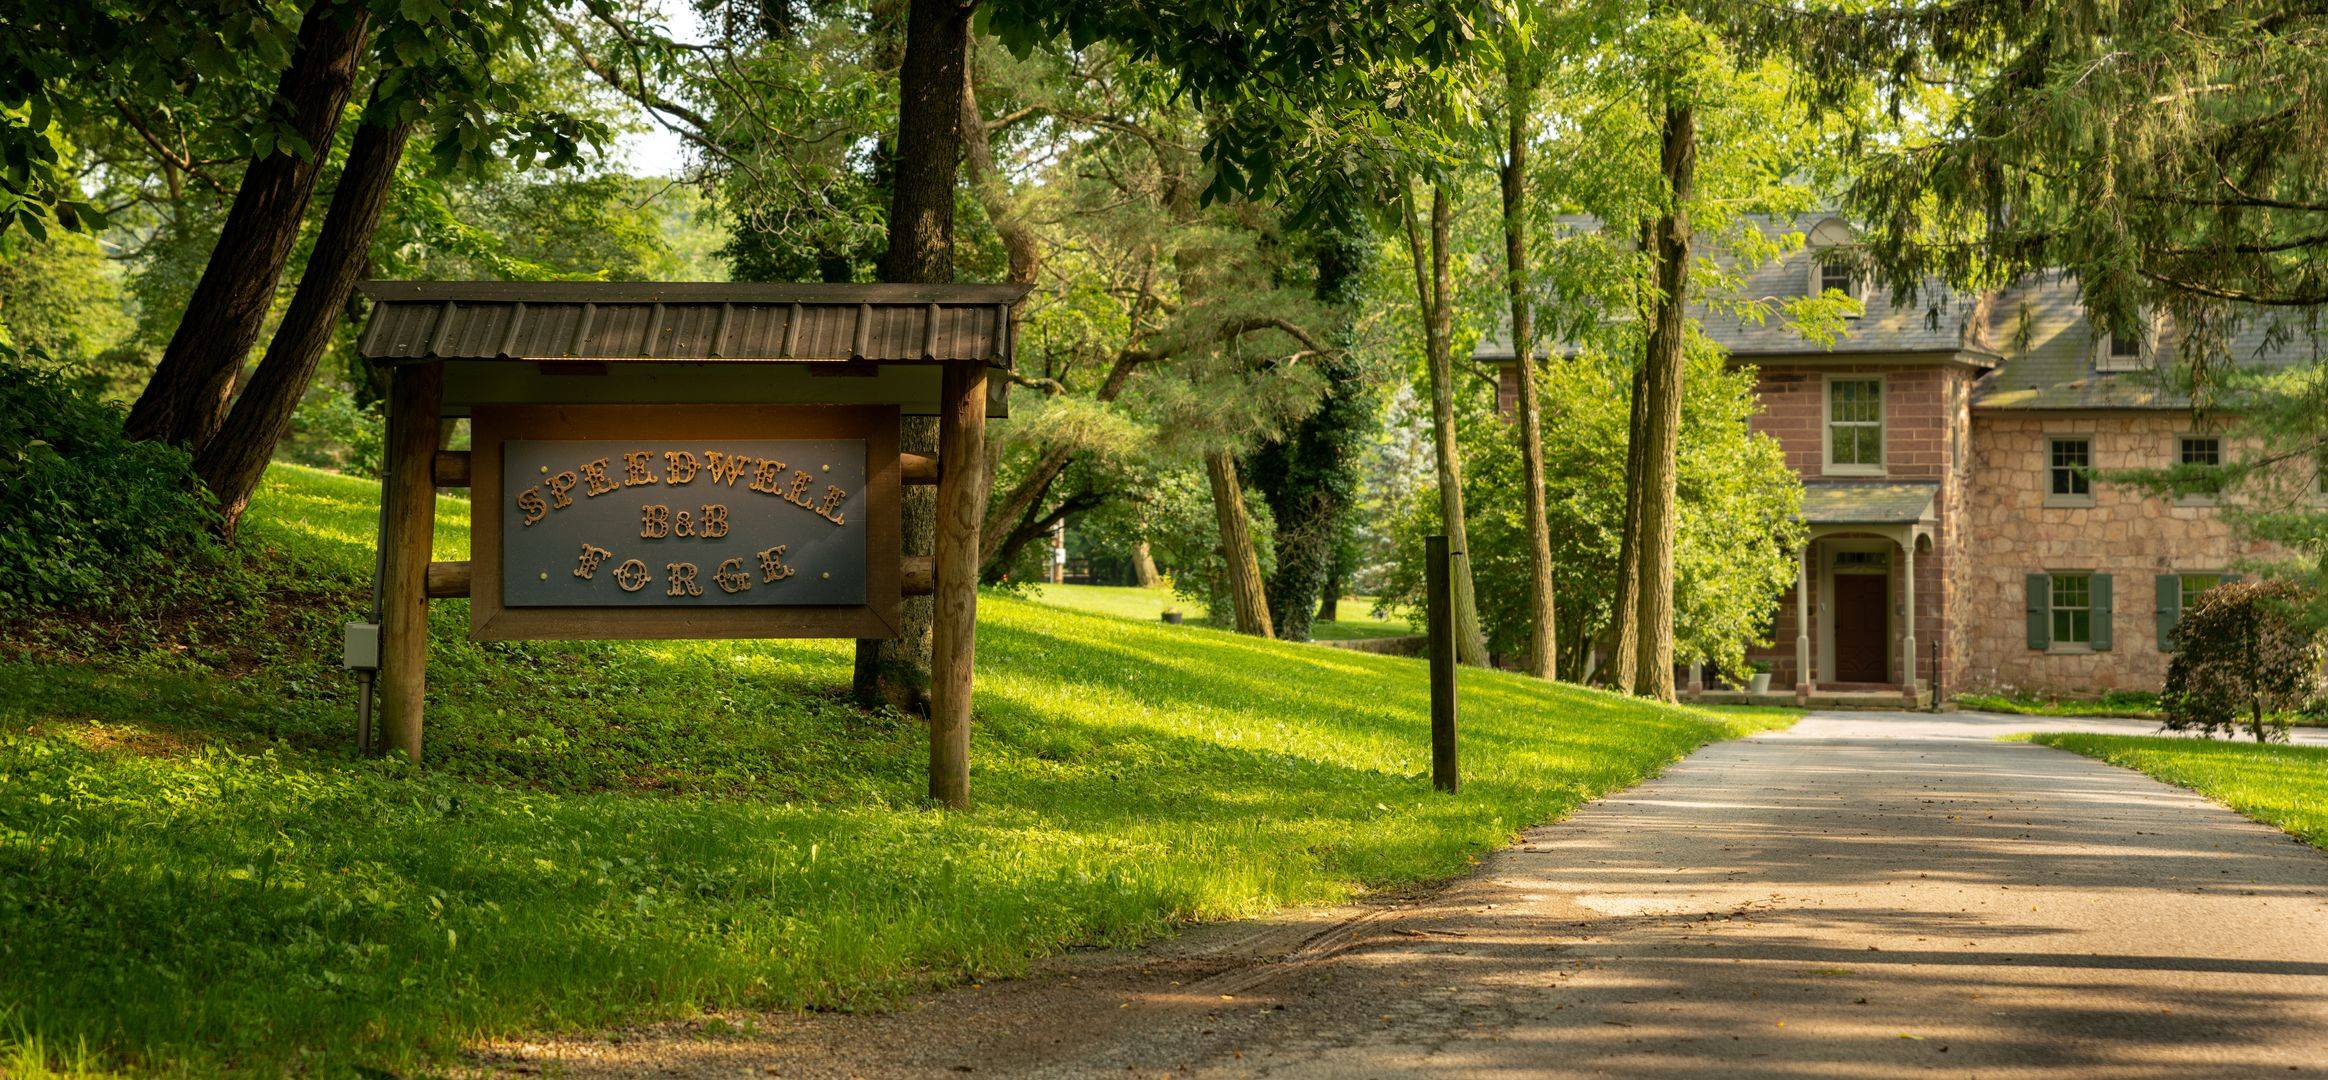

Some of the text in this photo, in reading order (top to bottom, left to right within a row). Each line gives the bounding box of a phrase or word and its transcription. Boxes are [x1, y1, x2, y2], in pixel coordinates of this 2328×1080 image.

[517, 450, 846, 526] SPEEDWELL
[640, 504, 729, 539] B&B
[573, 543, 796, 598] FORGE
